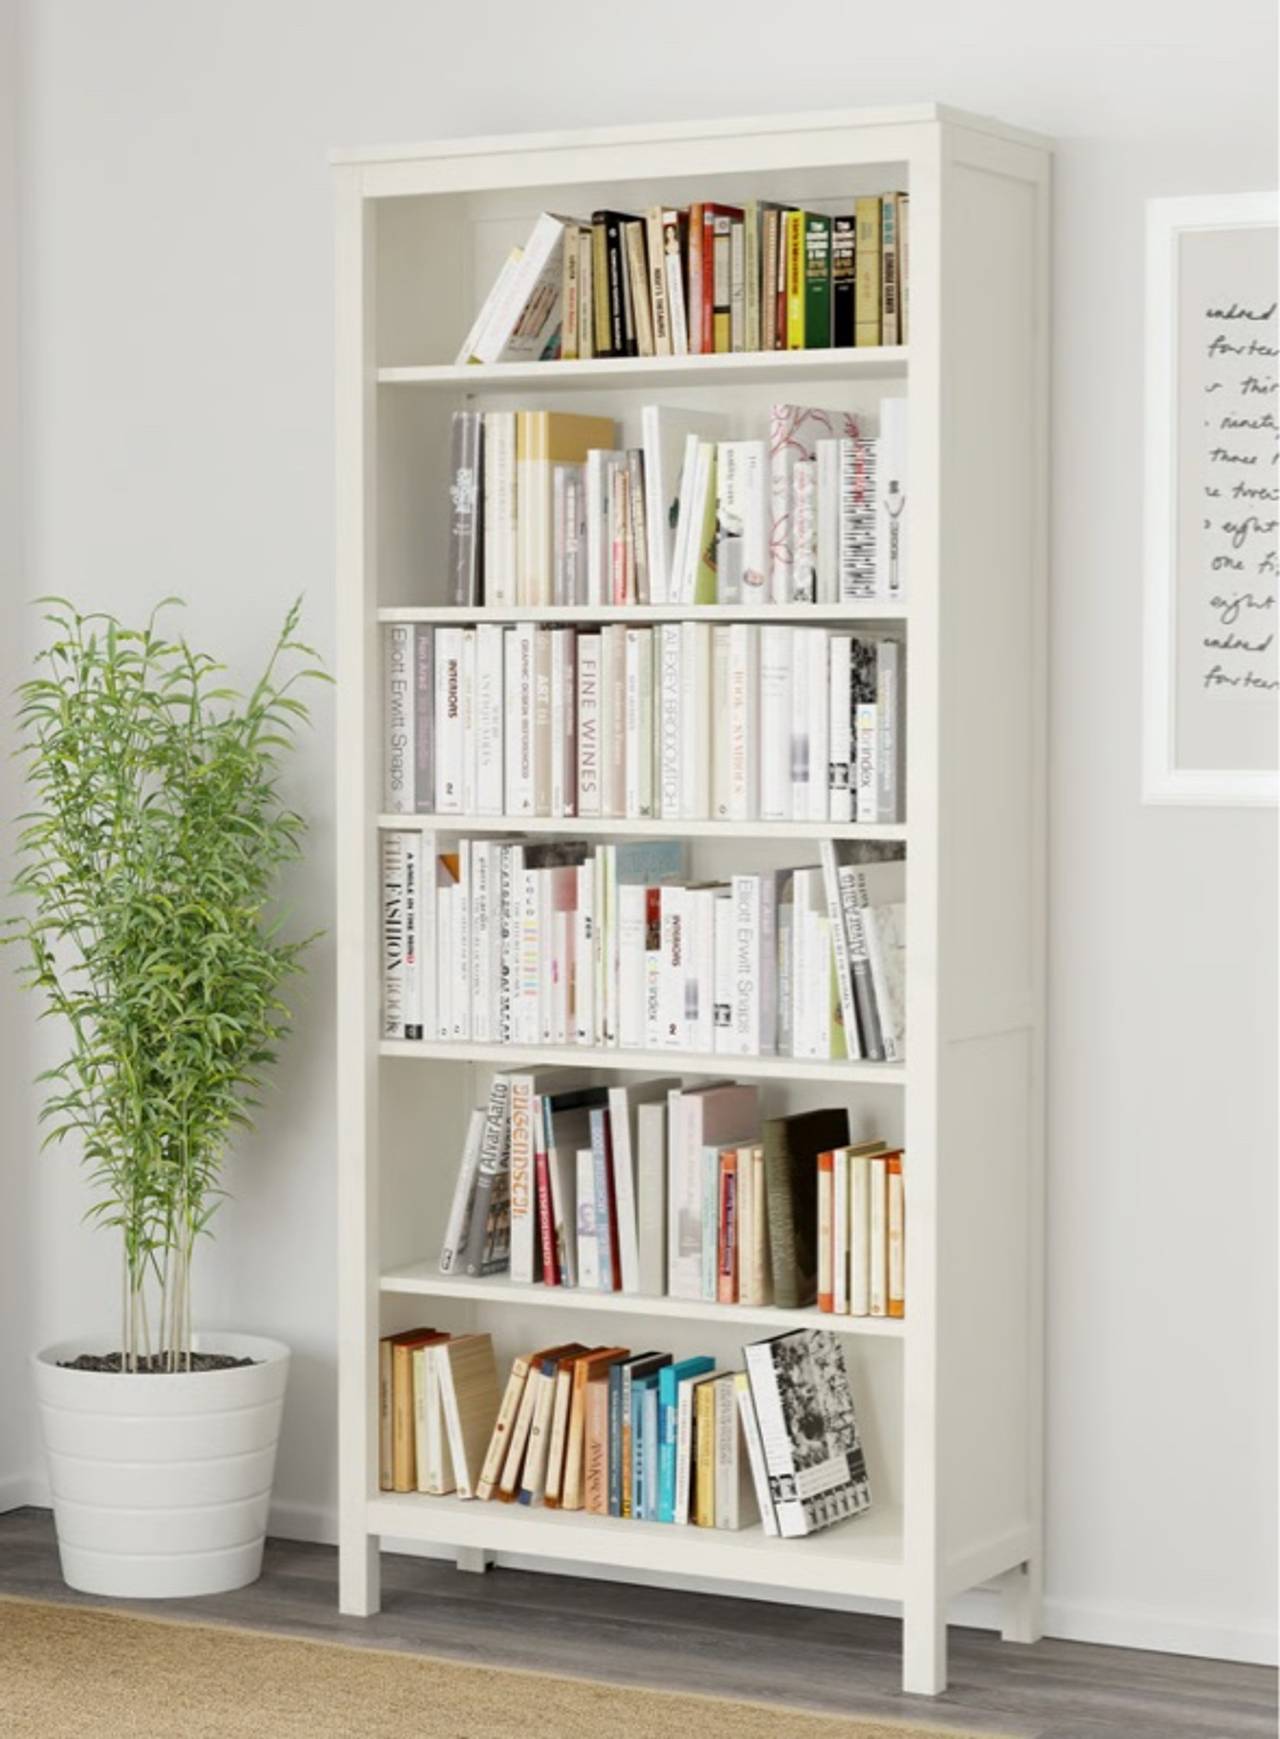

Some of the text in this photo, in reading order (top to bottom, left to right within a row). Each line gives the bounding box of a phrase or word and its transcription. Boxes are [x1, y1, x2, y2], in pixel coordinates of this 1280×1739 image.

[390, 734, 408, 793] Snaps
[582, 660, 597, 793] FINE WINES
[385, 882, 402, 971] FASHION
